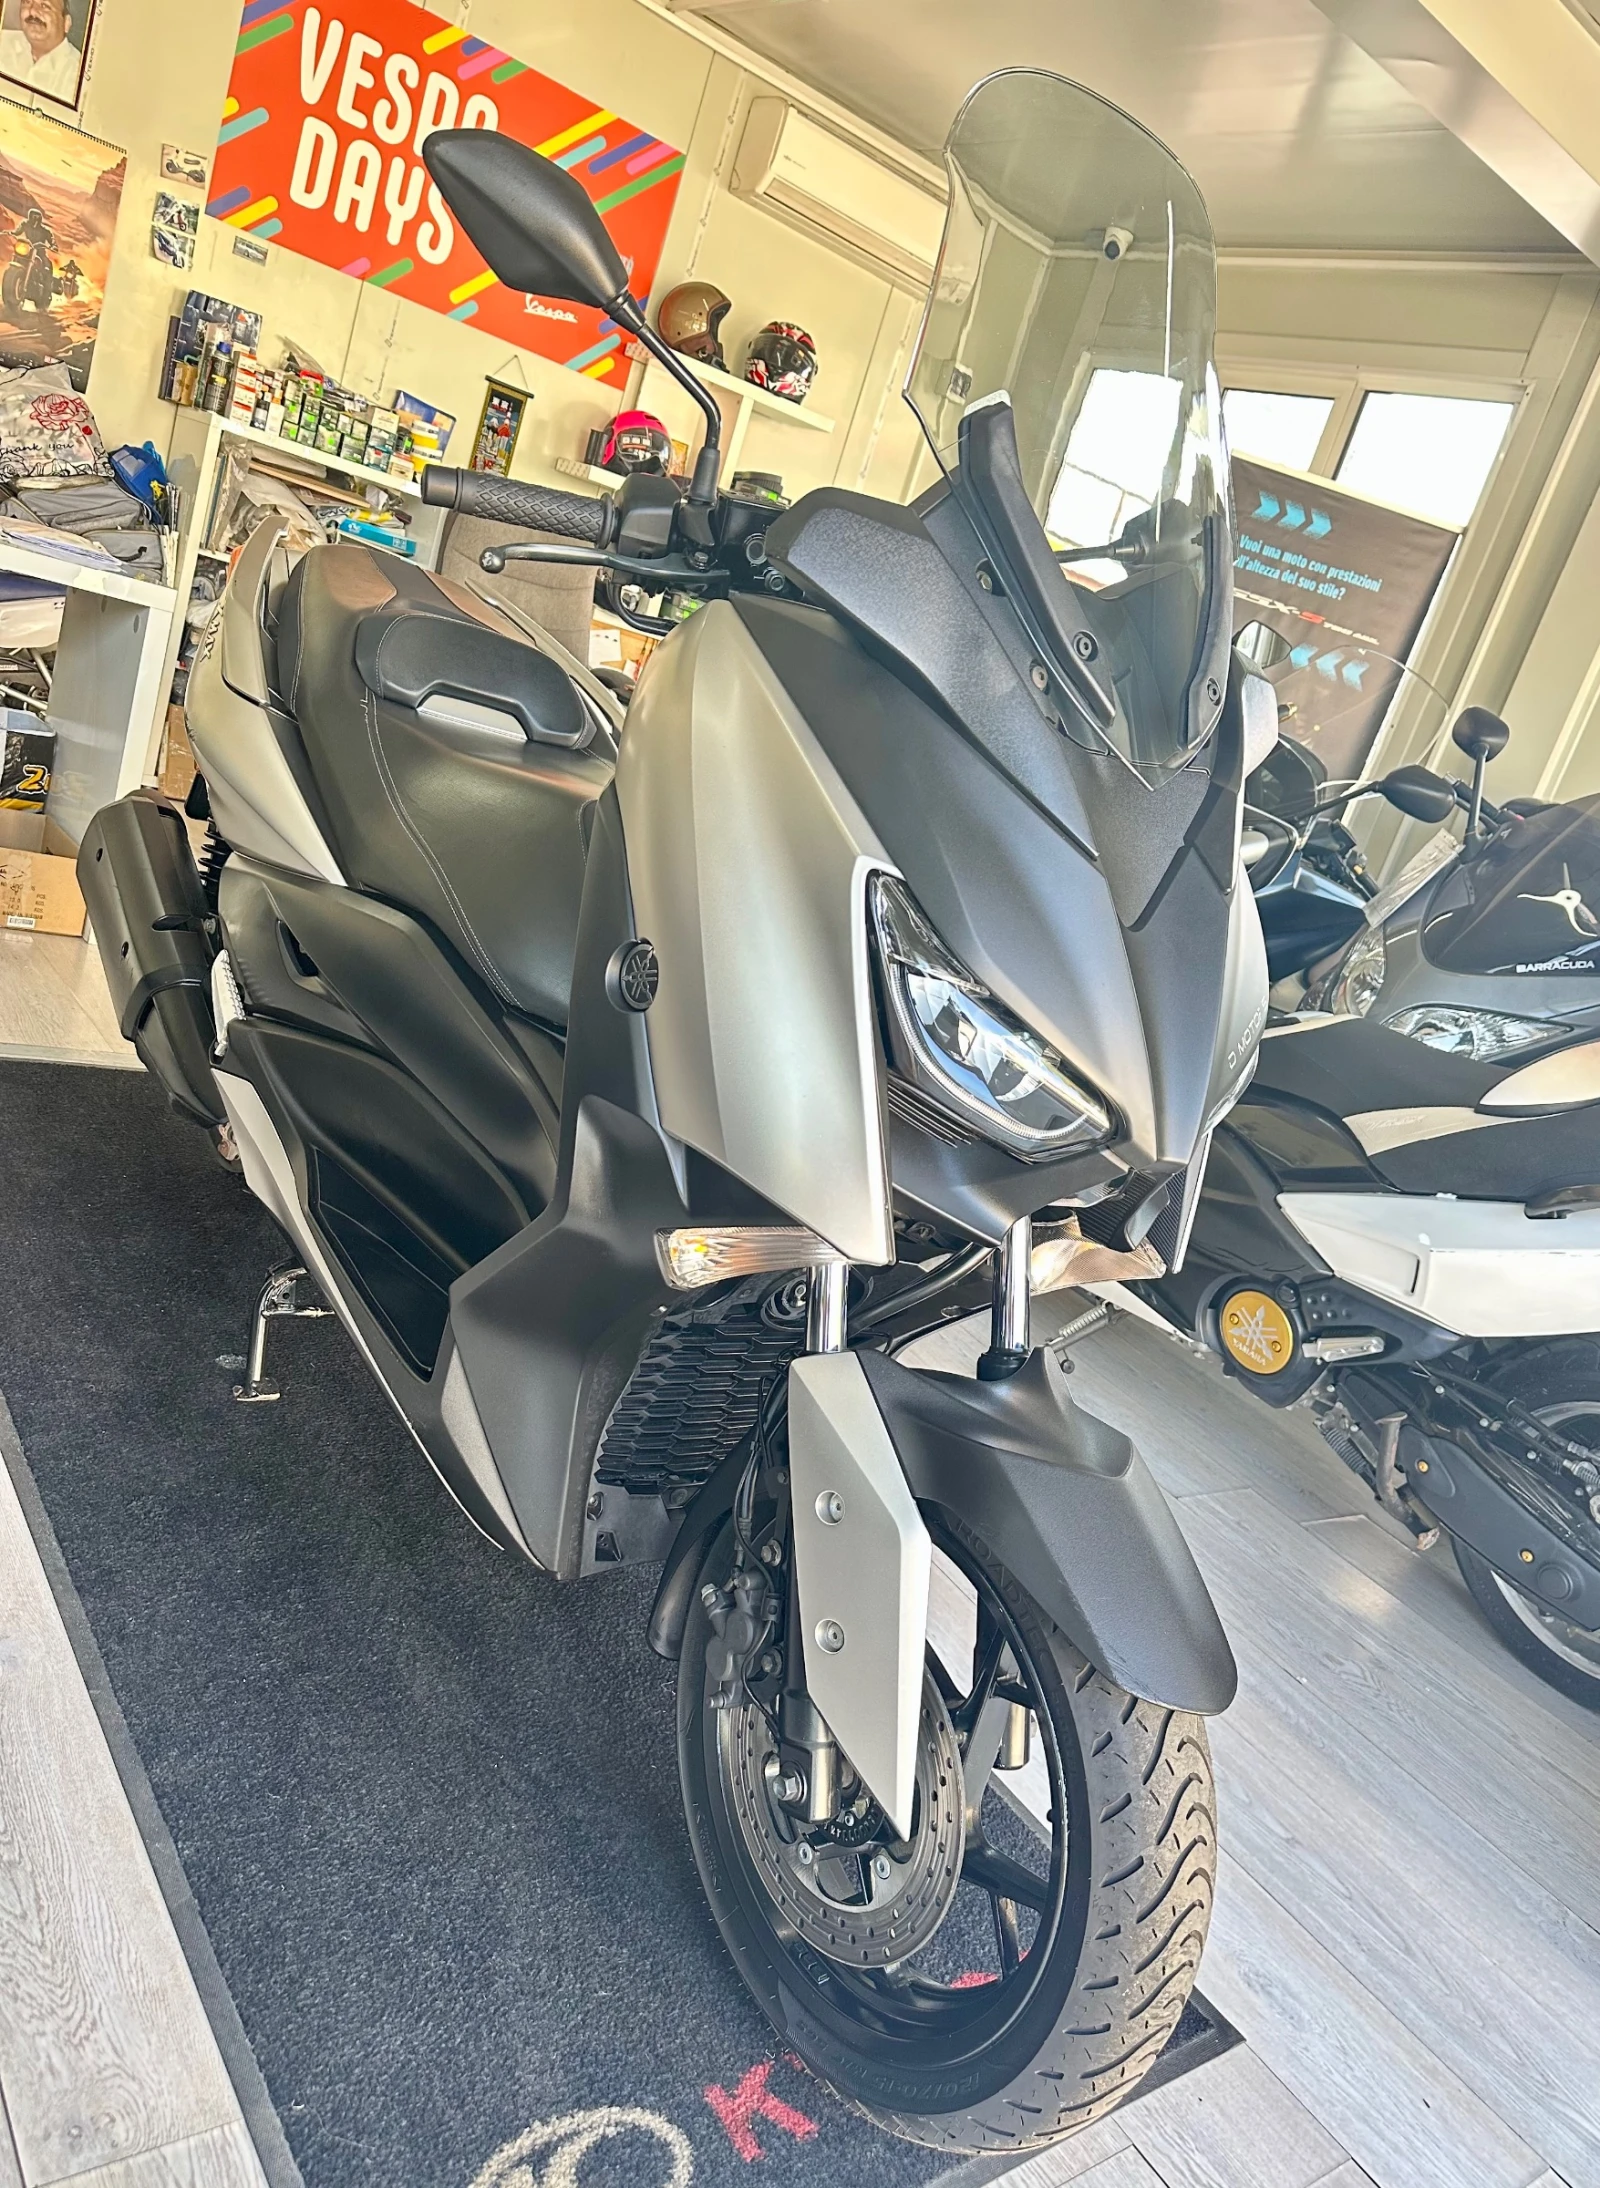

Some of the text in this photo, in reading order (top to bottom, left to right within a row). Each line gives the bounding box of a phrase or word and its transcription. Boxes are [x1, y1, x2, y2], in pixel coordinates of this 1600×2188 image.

[289, 116, 454, 265] DAYS
[523, 293, 579, 324] Vespa
[1239, 534, 1383, 593] Vuoi una moto con prestazioni
[1281, 569, 1299, 585] del
[1298, 576, 1316, 591] suo
[1316, 580, 1346, 600] stile?
[1516, 960, 1595, 974] BARRACUDA
[1232, 1337, 1267, 1367] YAMAHA
